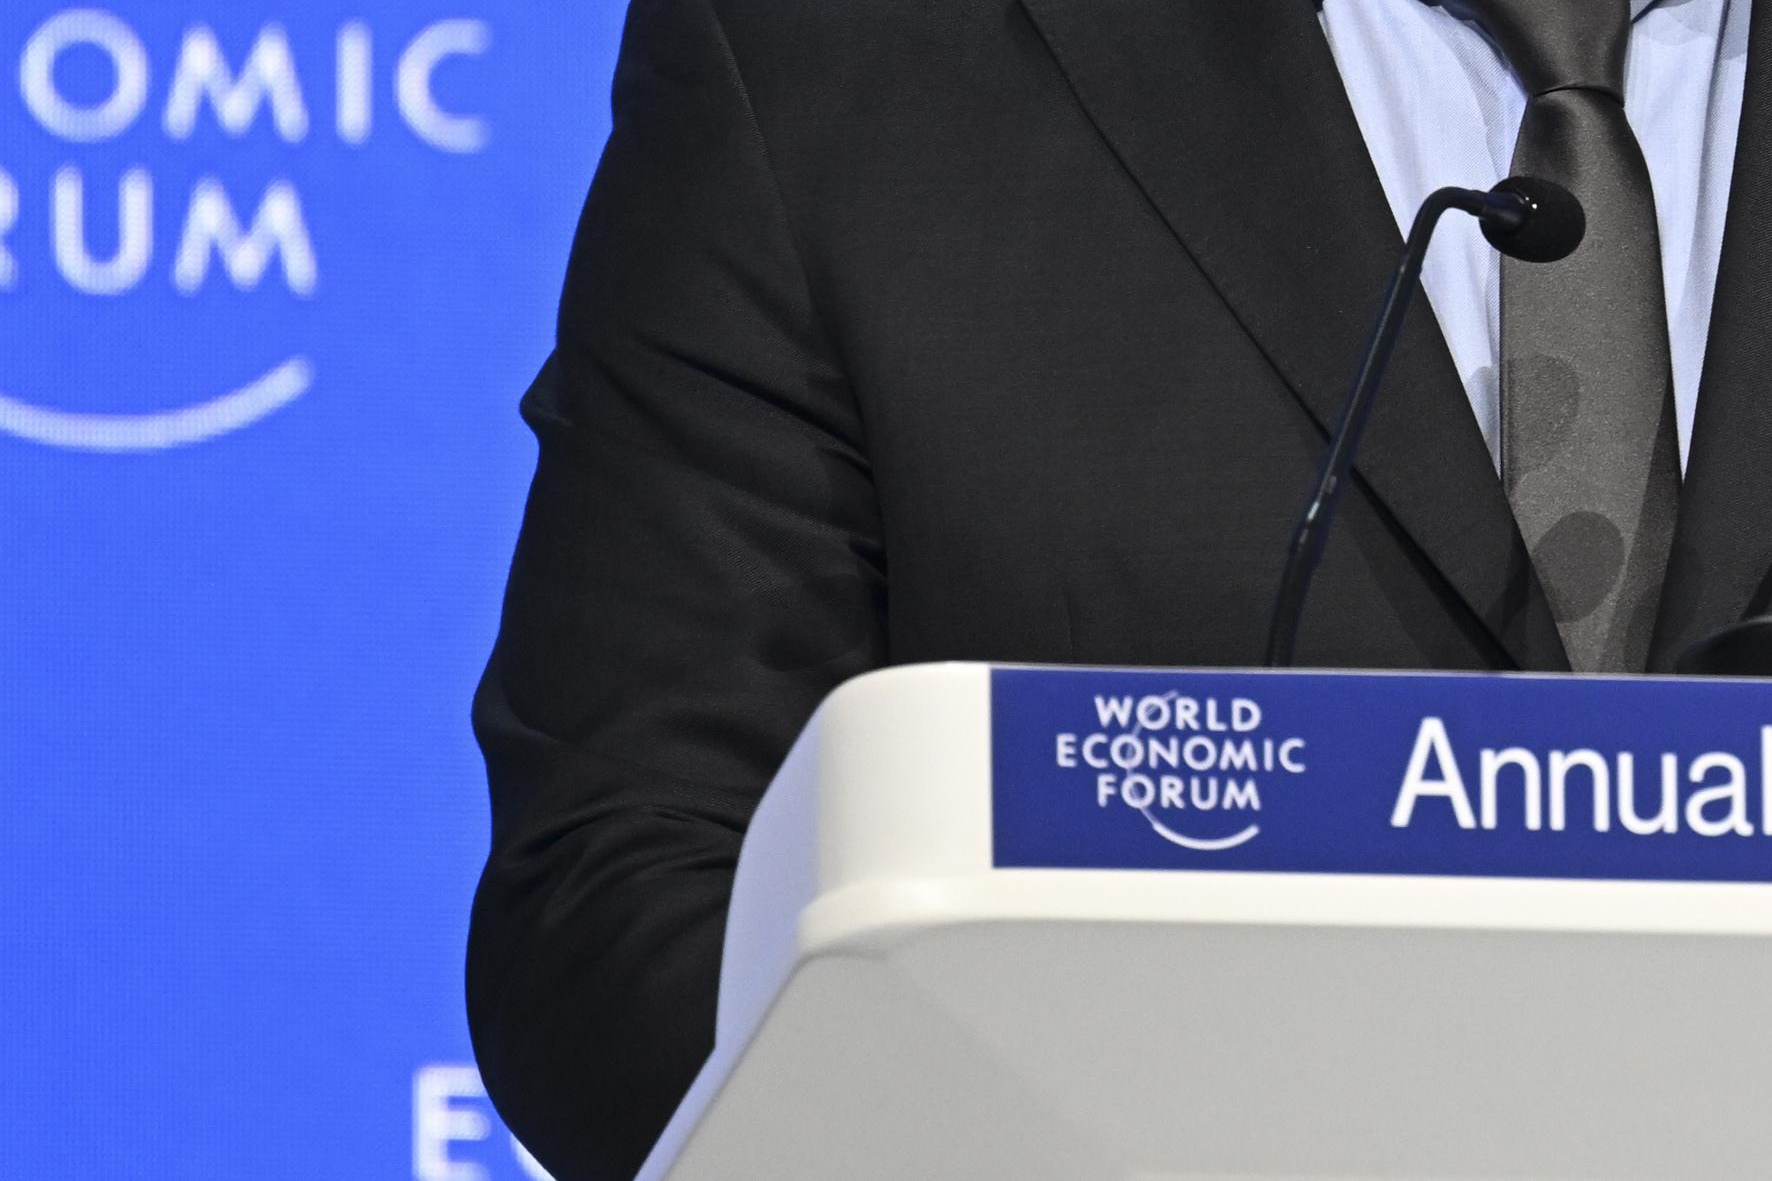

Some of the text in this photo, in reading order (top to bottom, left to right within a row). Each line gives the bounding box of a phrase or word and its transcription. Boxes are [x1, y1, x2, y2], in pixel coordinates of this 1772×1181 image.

[18, 9, 488, 153] OMIC
[0, 166, 318, 295] UM
[1095, 693, 1262, 732] WORLD
[1056, 732, 1306, 774] ECONOMIC
[1097, 772, 1261, 812] FORUM
